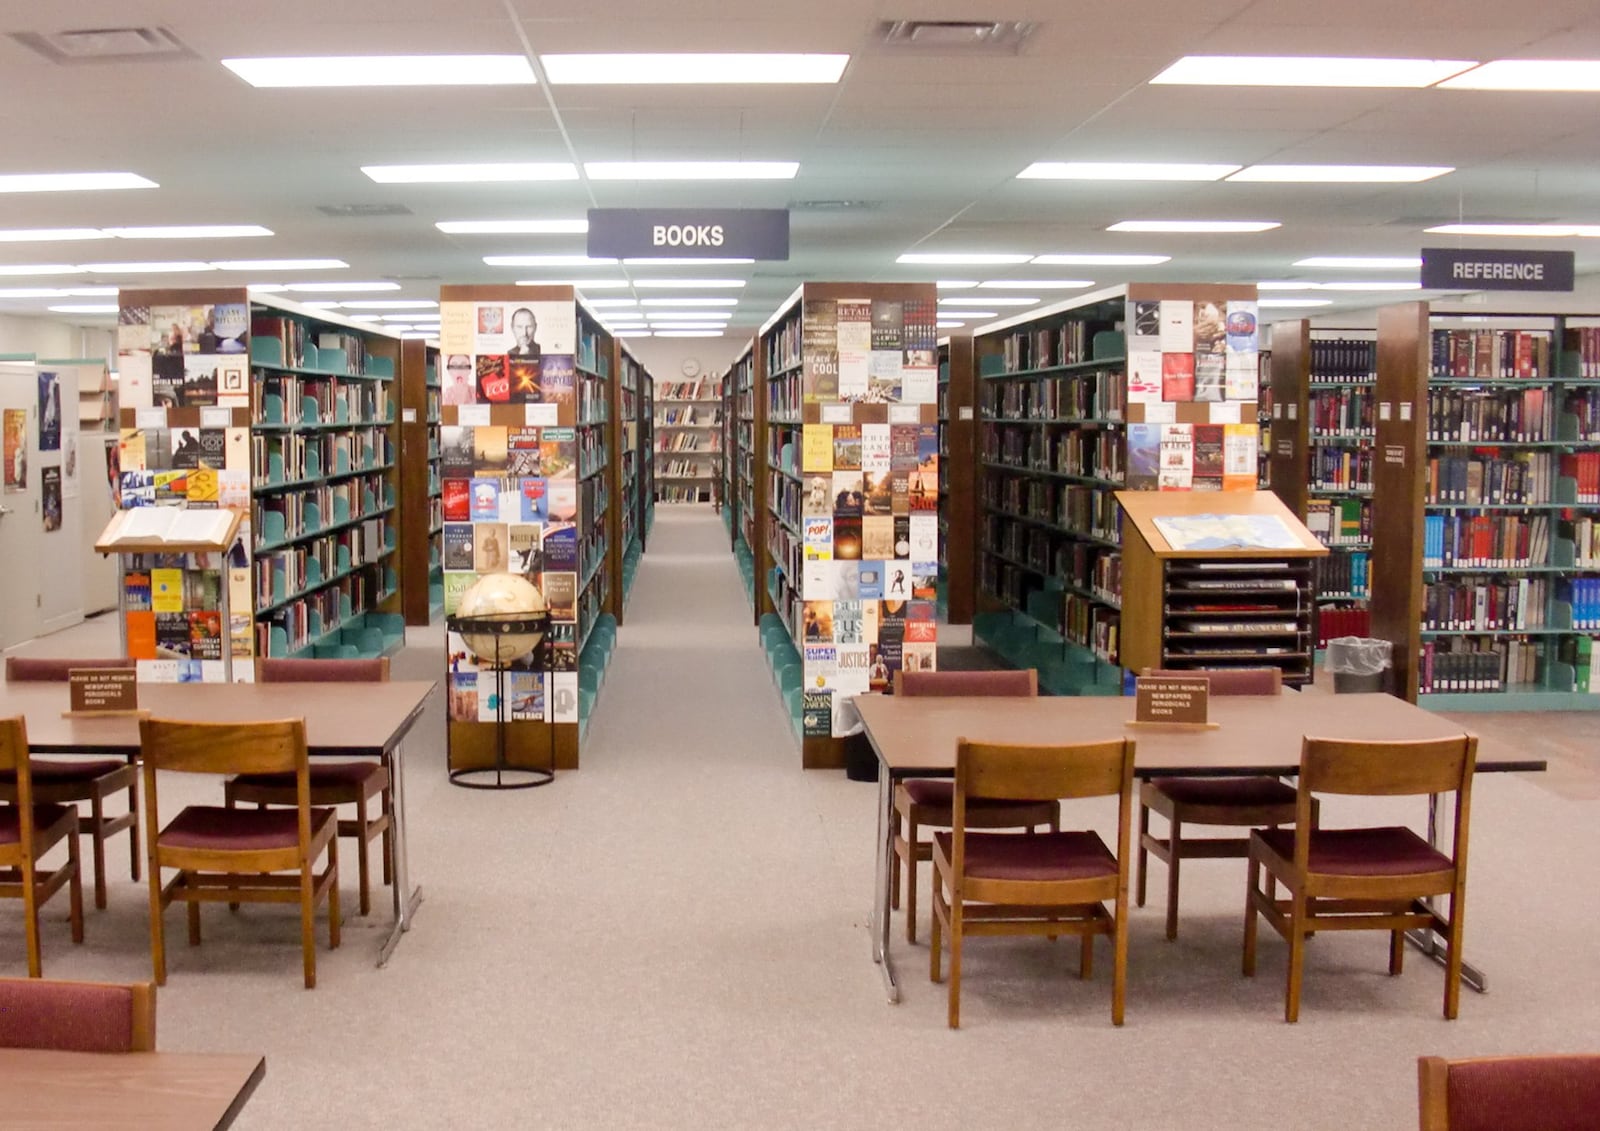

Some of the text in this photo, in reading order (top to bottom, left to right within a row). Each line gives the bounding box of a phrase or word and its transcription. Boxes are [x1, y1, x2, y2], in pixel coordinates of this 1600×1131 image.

[653, 225, 724, 246] BOOKS
[1453, 262, 1544, 280] REFERENCE
[812, 363, 838, 375] COOL
[201, 437, 224, 448] GOD
[808, 525, 829, 535] POP!
[838, 652, 868, 668] JUSTICE
